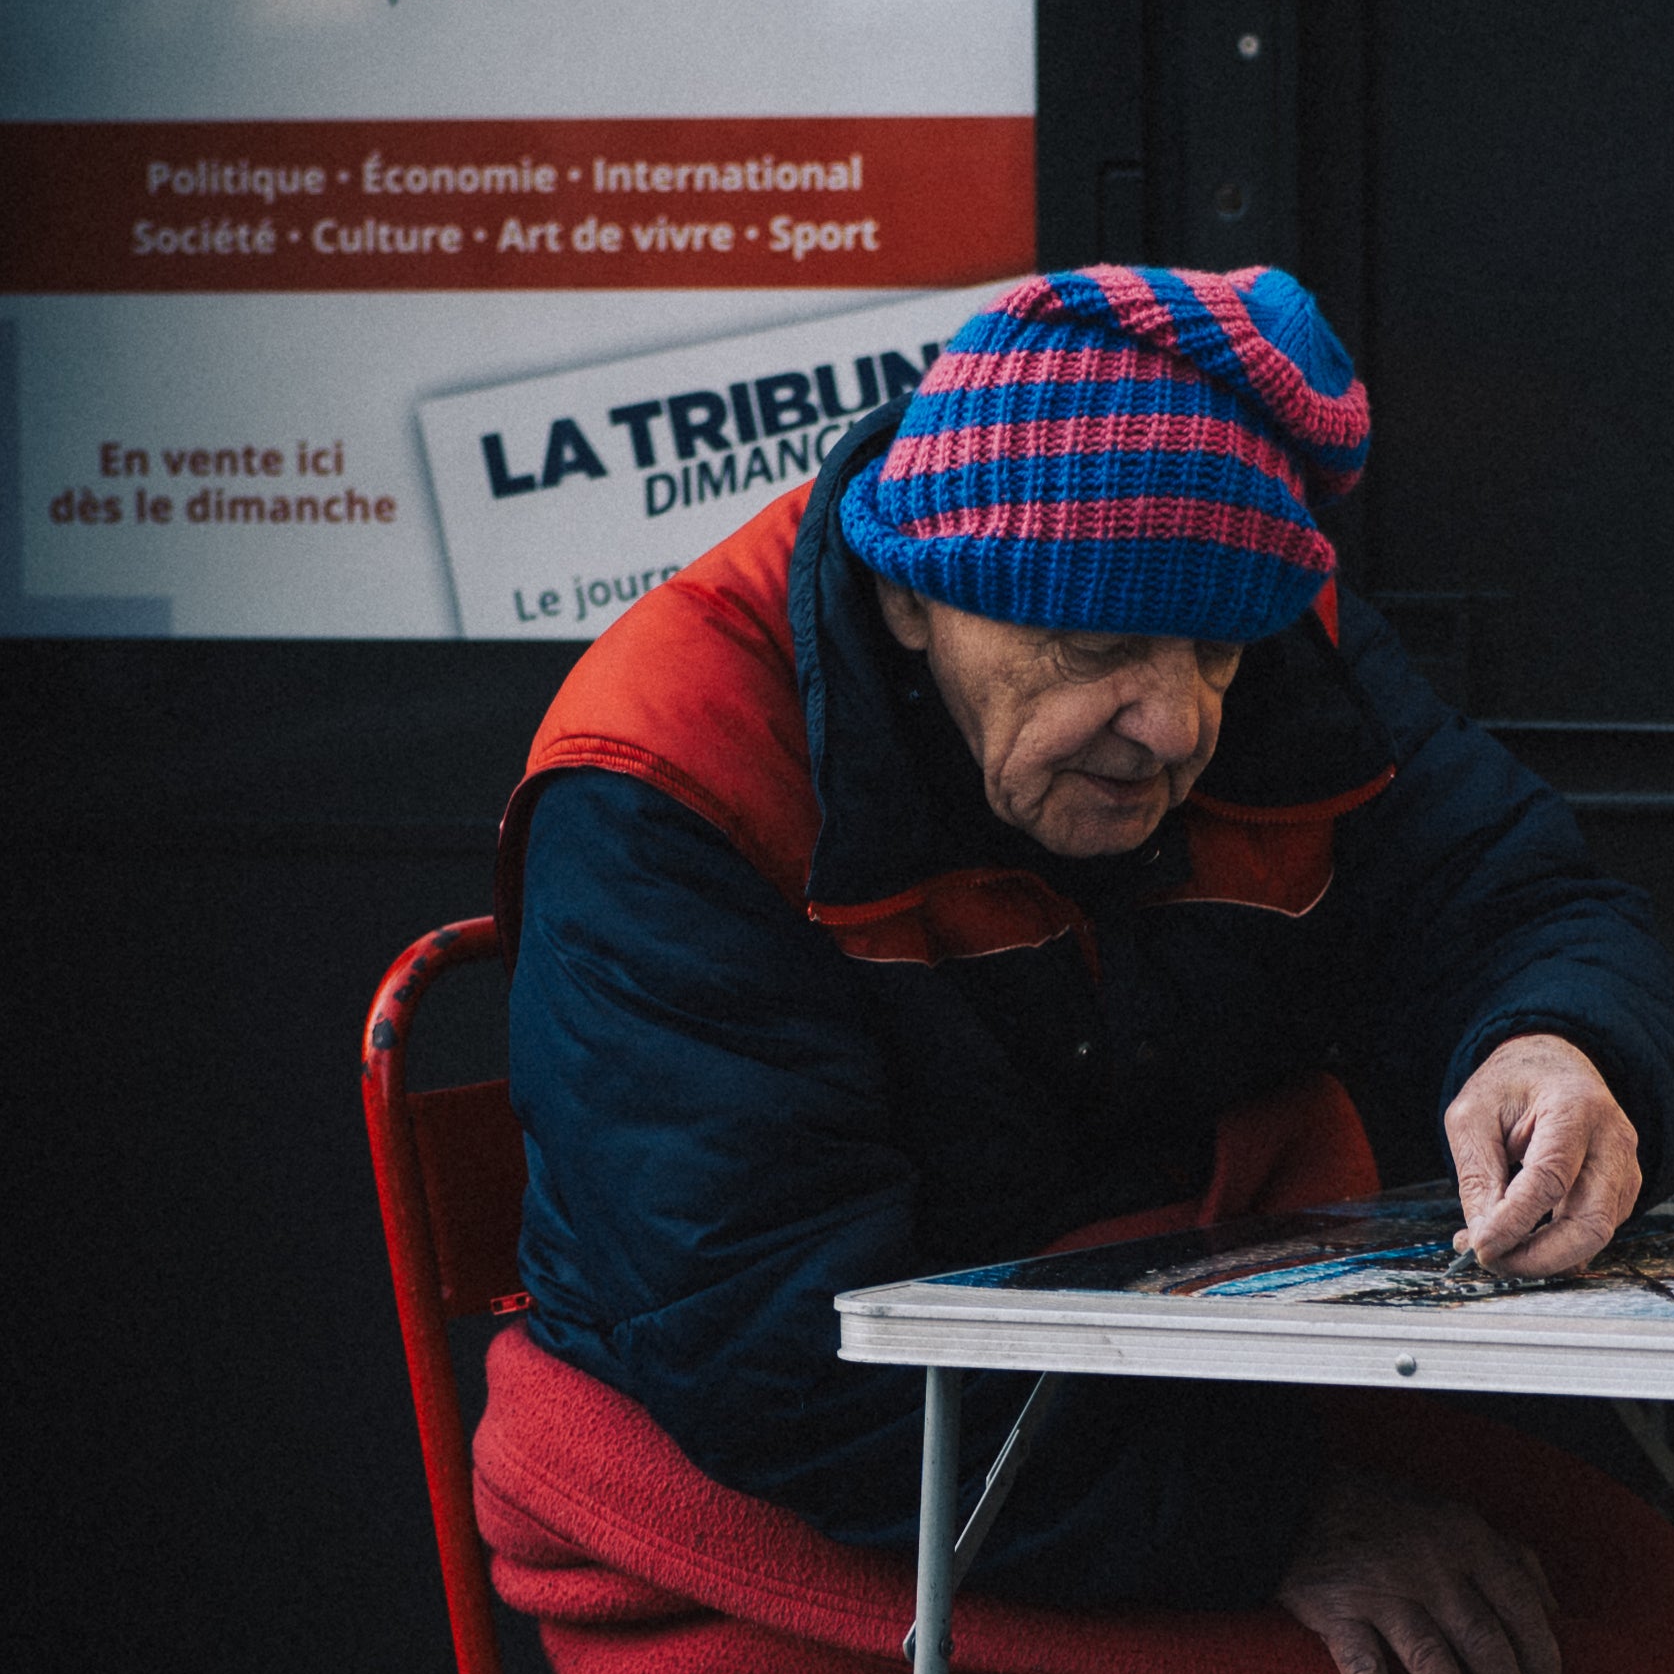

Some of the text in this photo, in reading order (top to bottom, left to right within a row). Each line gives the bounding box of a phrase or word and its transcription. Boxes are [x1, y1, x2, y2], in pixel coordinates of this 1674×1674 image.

[146, 151, 864, 204] Politique Économie International
[131, 213, 881, 262] Société Culture Art de vivre Sport
[481, 340, 952, 500] LA TRIBUN
[99, 439, 345, 478] En vente ici
[645, 420, 854, 518] DIMANC
[49, 486, 398, 524] dès le dimanche
[513, 585, 561, 624] Le
